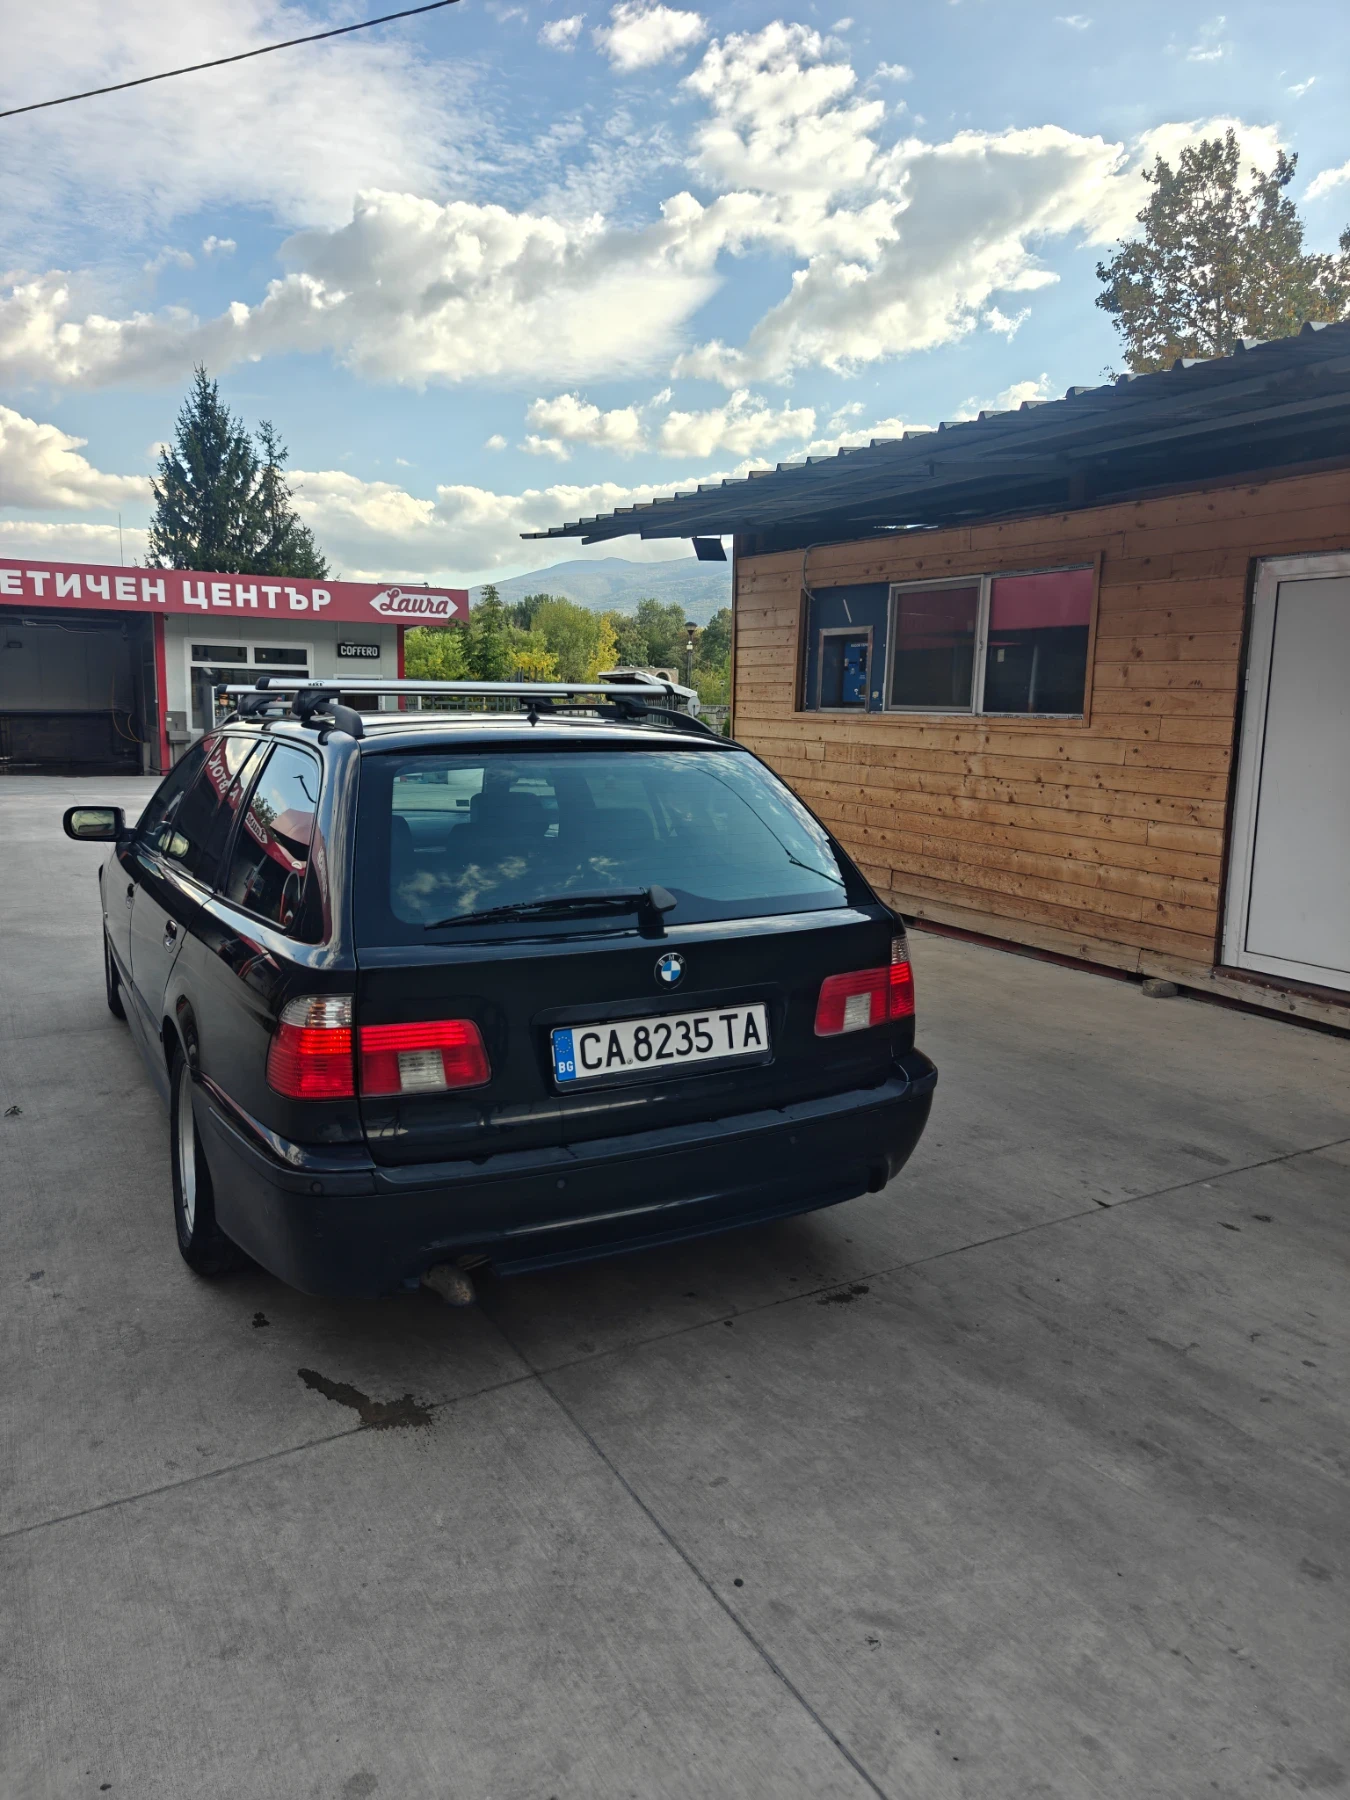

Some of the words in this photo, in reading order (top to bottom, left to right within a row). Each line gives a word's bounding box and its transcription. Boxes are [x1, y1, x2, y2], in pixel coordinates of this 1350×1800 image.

[0, 568, 166, 603] ЕТИЧЕН
[182, 580, 332, 611] ЦЕНТЪР
[379, 589, 449, 615] Laura
[340, 645, 378, 656] COFFERO
[658, 954, 685, 967] BMW
[558, 1060, 574, 1073] BG
